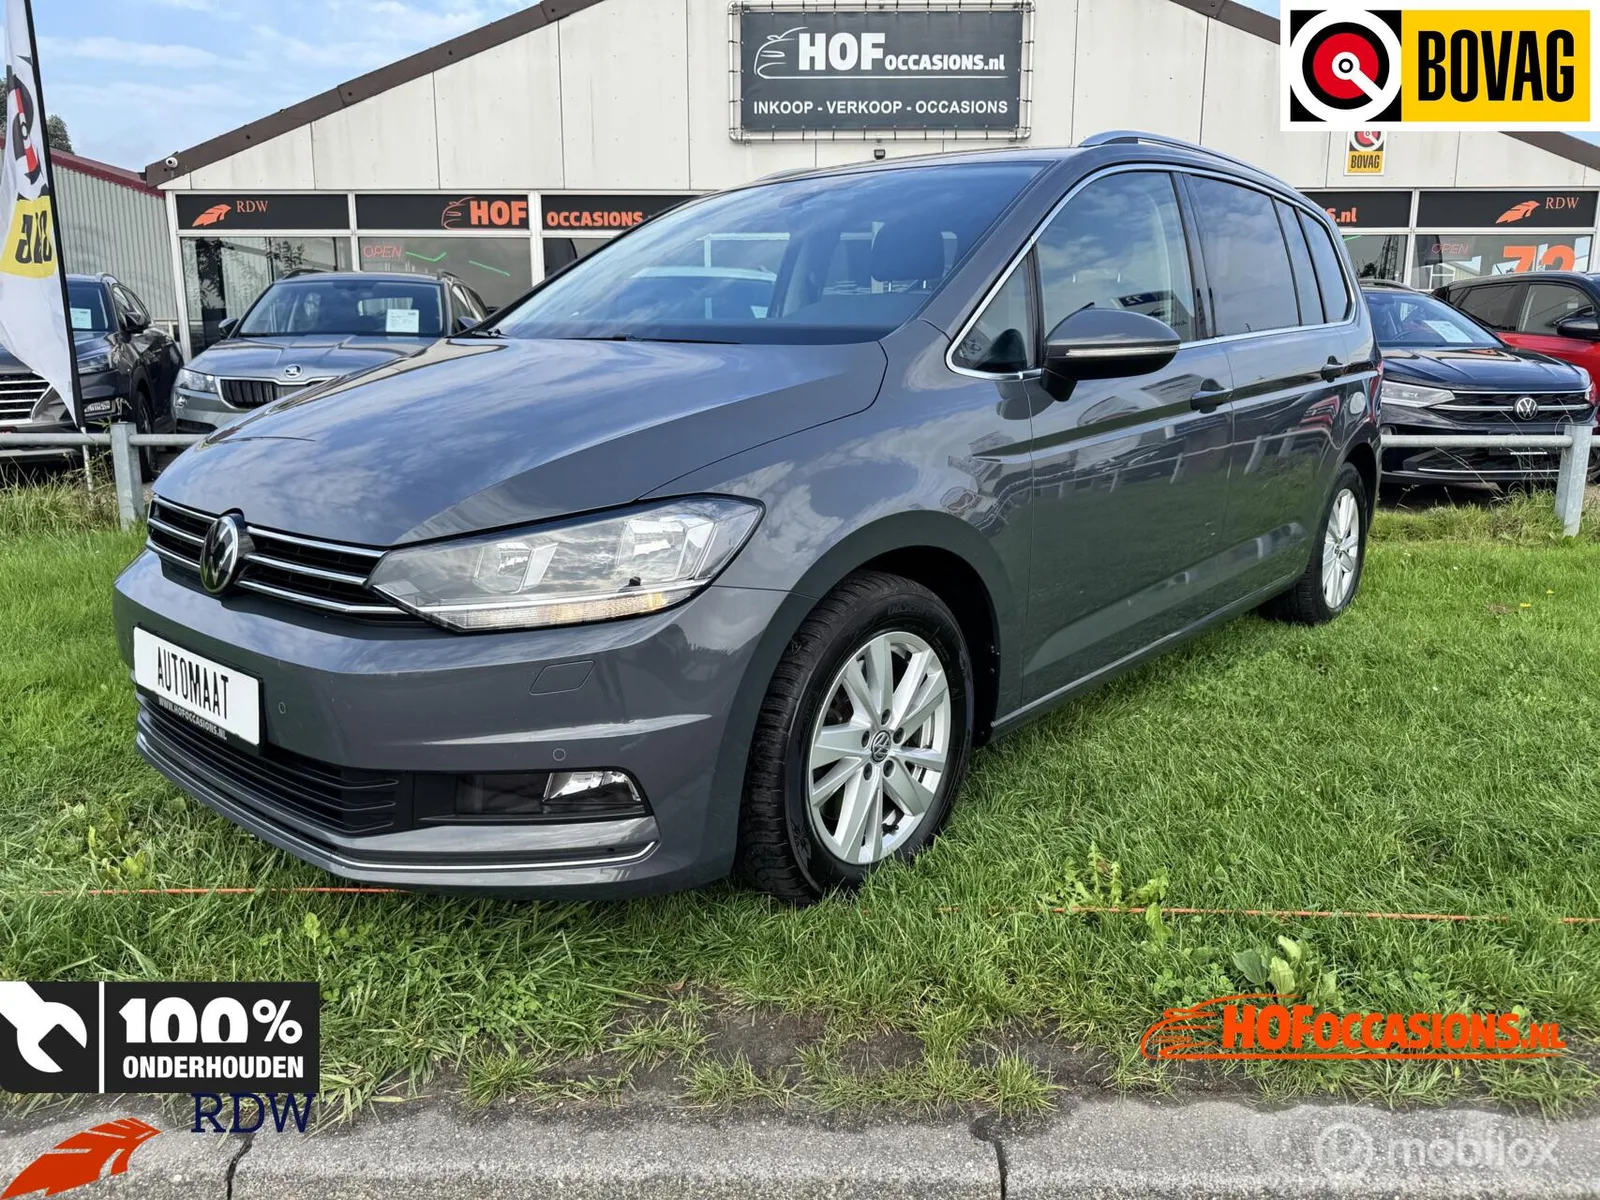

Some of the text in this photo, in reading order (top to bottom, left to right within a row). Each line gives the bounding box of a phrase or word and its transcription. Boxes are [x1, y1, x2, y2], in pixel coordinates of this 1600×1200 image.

[753, 100, 813, 115] INKOOP
[826, 100, 902, 114] VERKOOP
[915, 100, 1008, 114] OCCASIONS
[1350, 154, 1380, 169] BOVAG
[236, 200, 268, 213] RDW
[1545, 197, 1579, 209] RDW
[469, 200, 527, 226] HOF
[546, 211, 643, 227] OCCASIONS
[363, 245, 402, 258] OPEN
[1431, 243, 1468, 255] OPEN
[157, 646, 229, 719] AUTOMAAT
